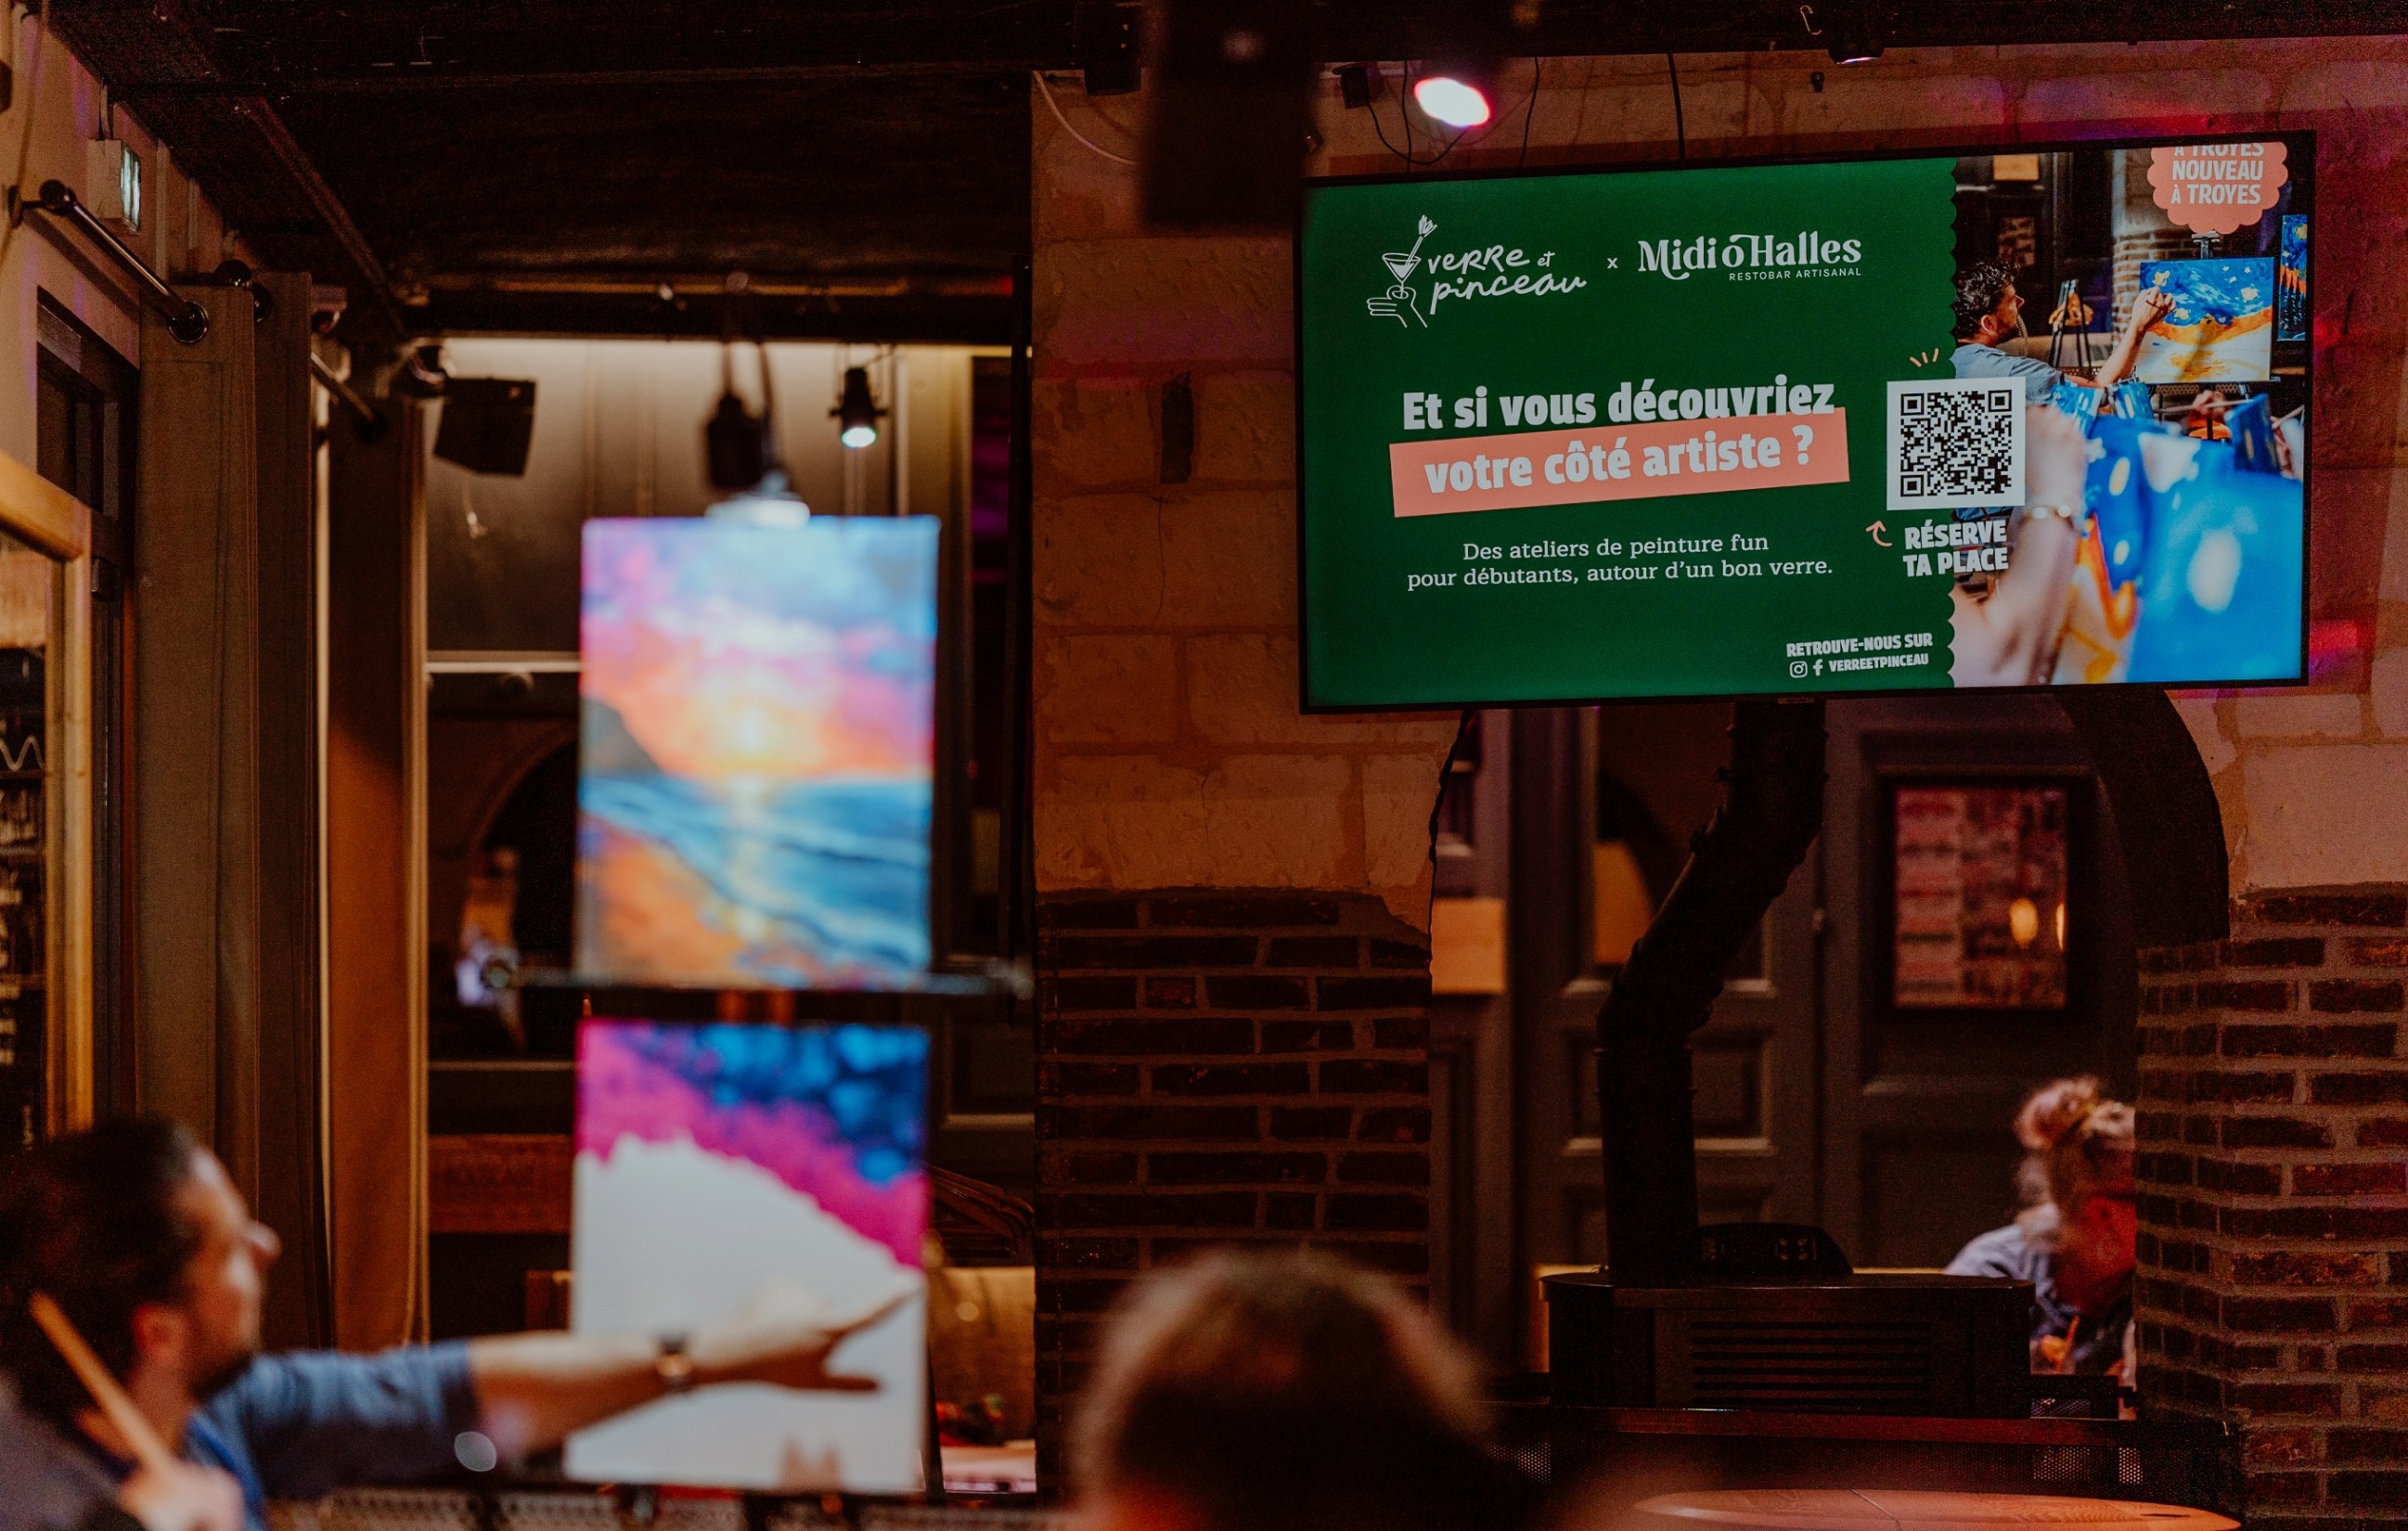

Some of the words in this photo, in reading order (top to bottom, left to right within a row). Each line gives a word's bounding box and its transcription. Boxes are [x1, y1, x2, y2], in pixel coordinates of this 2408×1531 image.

[2172, 160, 2264, 181] NOUVEAU
[2170, 185, 2182, 205] À
[2186, 184, 2261, 205] TROYES
[1537, 251, 1556, 267] et
[1729, 270, 1791, 281] RESTOBAR
[1795, 267, 1861, 278] ARTISANAL
[1429, 273, 1588, 315] pinceau
[1403, 392, 1444, 431] Et
[1454, 385, 1488, 429] si
[1499, 392, 1597, 427] vous
[1607, 373, 1835, 423] découvriez
[1423, 454, 1534, 494] votre
[1544, 436, 1632, 484] côté
[1642, 430, 1782, 478] artiste
[1791, 424, 1814, 466] ?
[1462, 543, 1502, 560] Des
[1509, 540, 1590, 559] ateliers
[1596, 538, 1622, 556] de
[1629, 536, 1723, 560] peinture
[1731, 534, 1770, 551] fun
[1904, 519, 2007, 550] RÉSERVE
[1902, 554, 1932, 577] TA
[1937, 547, 2009, 575] PLACE
[1407, 573, 1458, 592] pour
[1463, 567, 1579, 585] débutants,
[1587, 564, 1658, 582] autour
[1721, 560, 1763, 577] bon
[1769, 560, 1834, 575] verre.
[1786, 635, 1902, 657] RETROUVE-NOUS
[1904, 632, 1933, 649] SUR
[1828, 652, 1929, 673] VERREETPINCEAU
